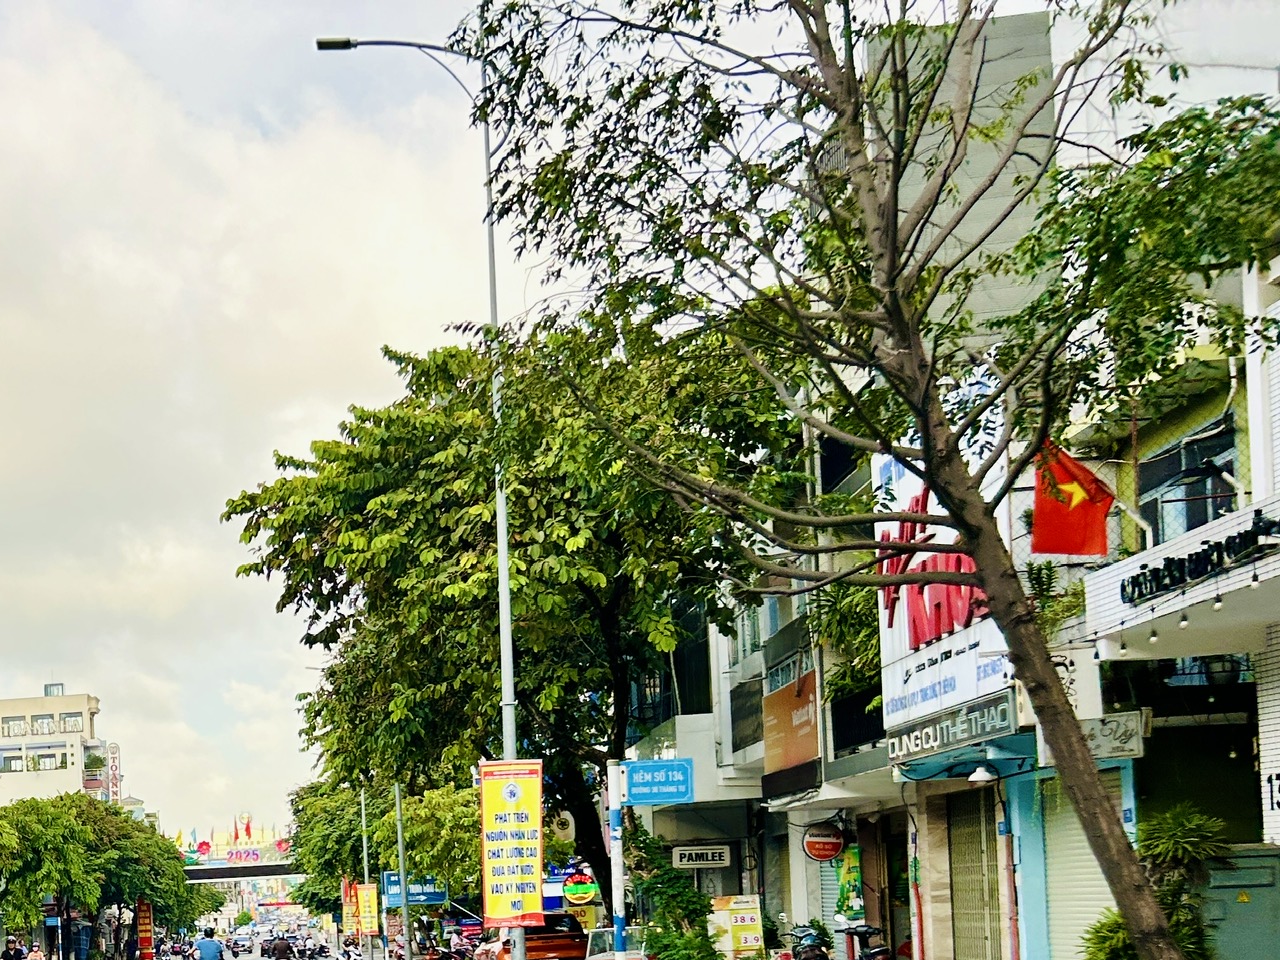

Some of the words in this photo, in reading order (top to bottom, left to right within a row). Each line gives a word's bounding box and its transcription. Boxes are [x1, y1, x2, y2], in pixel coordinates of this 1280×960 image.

[888, 731, 921, 759] DỤNG
[922, 724, 940, 750] CỤ
[939, 706, 968, 743] THỂ
[967, 702, 1009, 735] THAO
[668, 770, 684, 782] 134
[227, 849, 259, 863] 2025
[679, 851, 725, 862] PAMLEE
